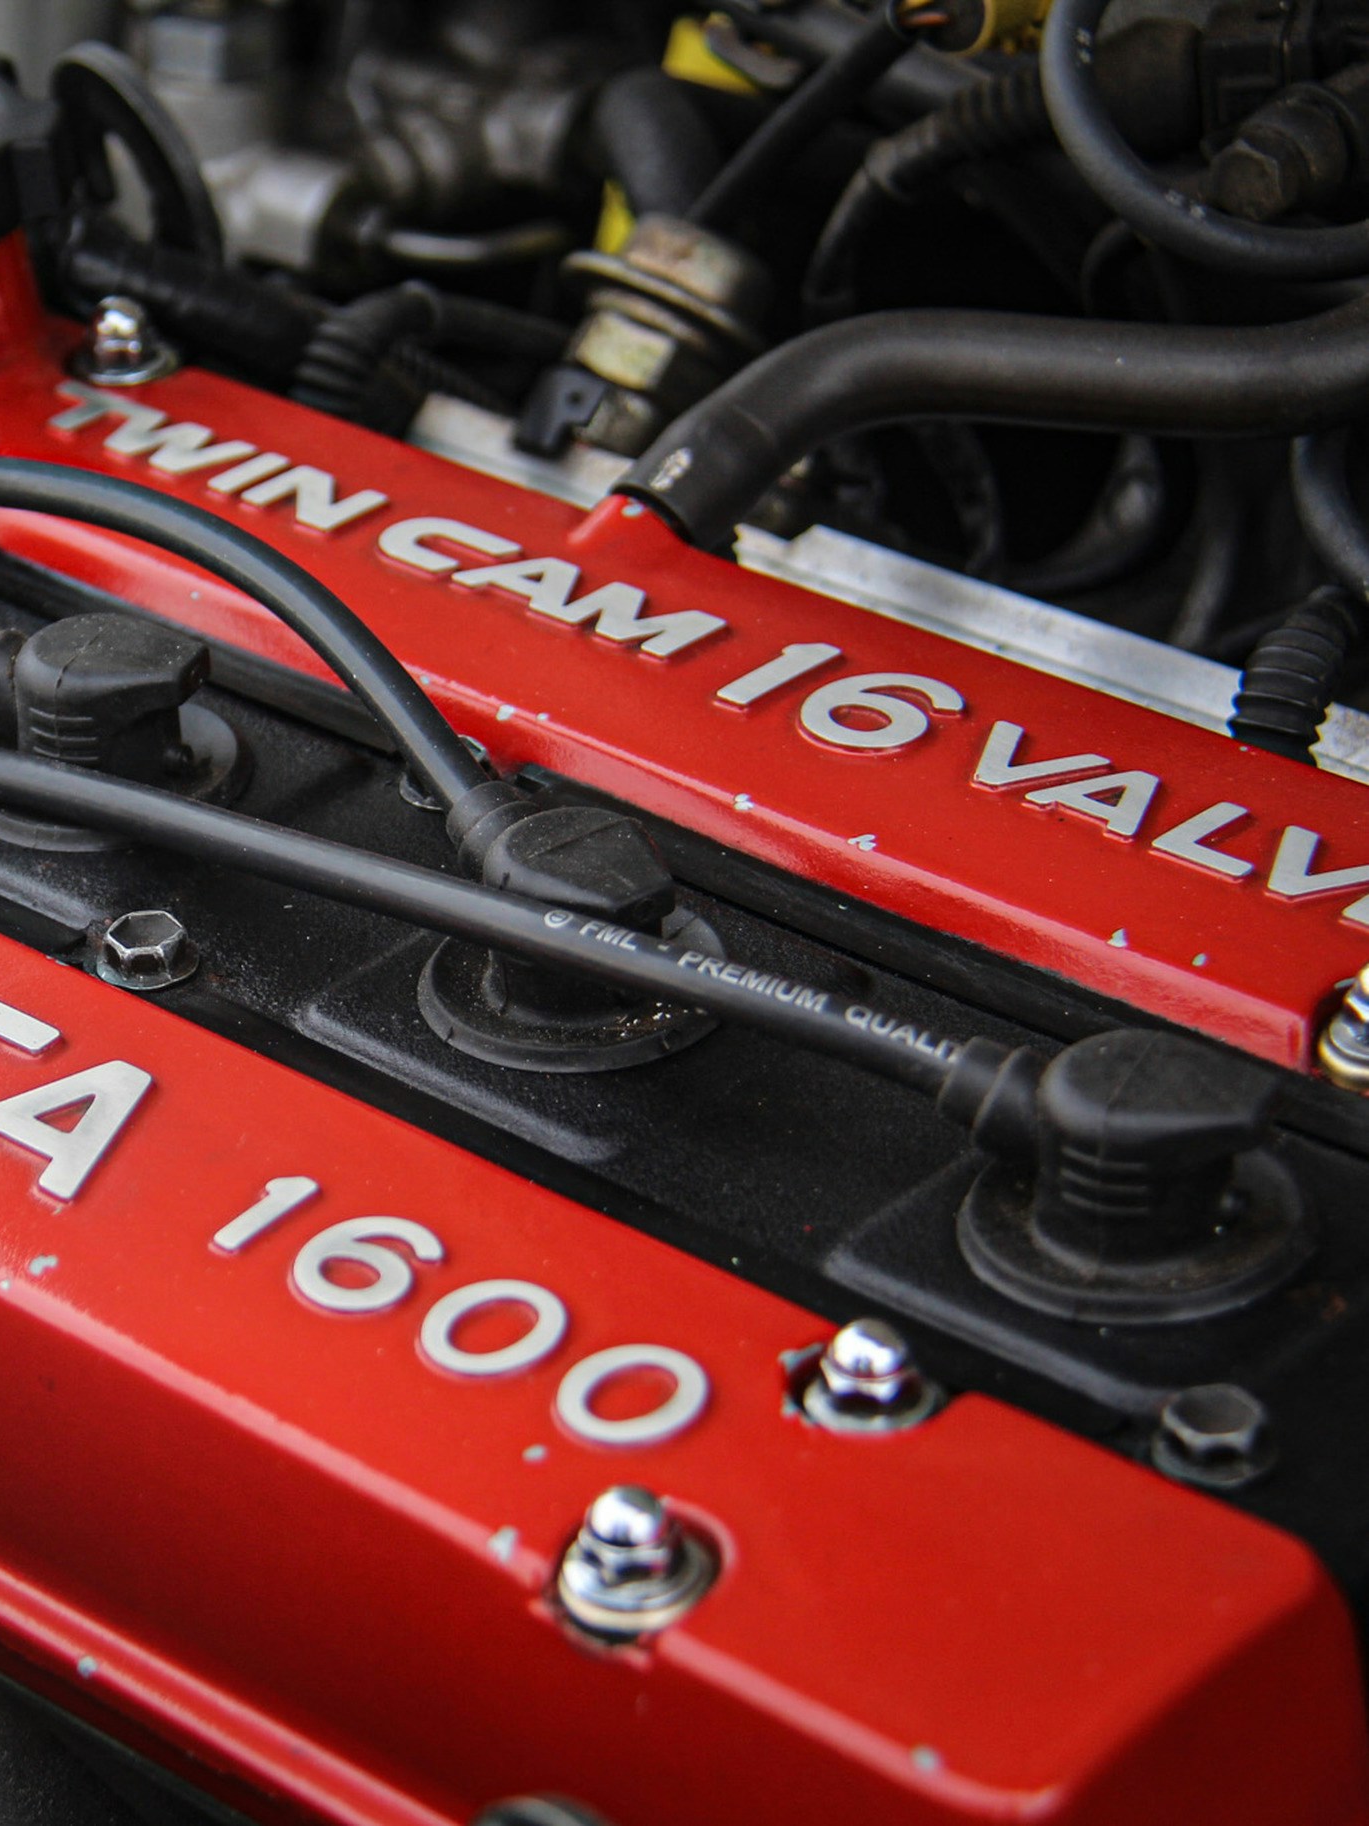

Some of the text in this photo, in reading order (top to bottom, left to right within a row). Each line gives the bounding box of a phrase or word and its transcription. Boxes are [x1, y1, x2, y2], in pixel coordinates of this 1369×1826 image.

[48, 383, 1369, 928] TWIN CAM 16 VALV
[578, 919, 638, 951] FML
[676, 950, 828, 1012] PREMIUM
[211, 1175, 710, 1445] 1600
